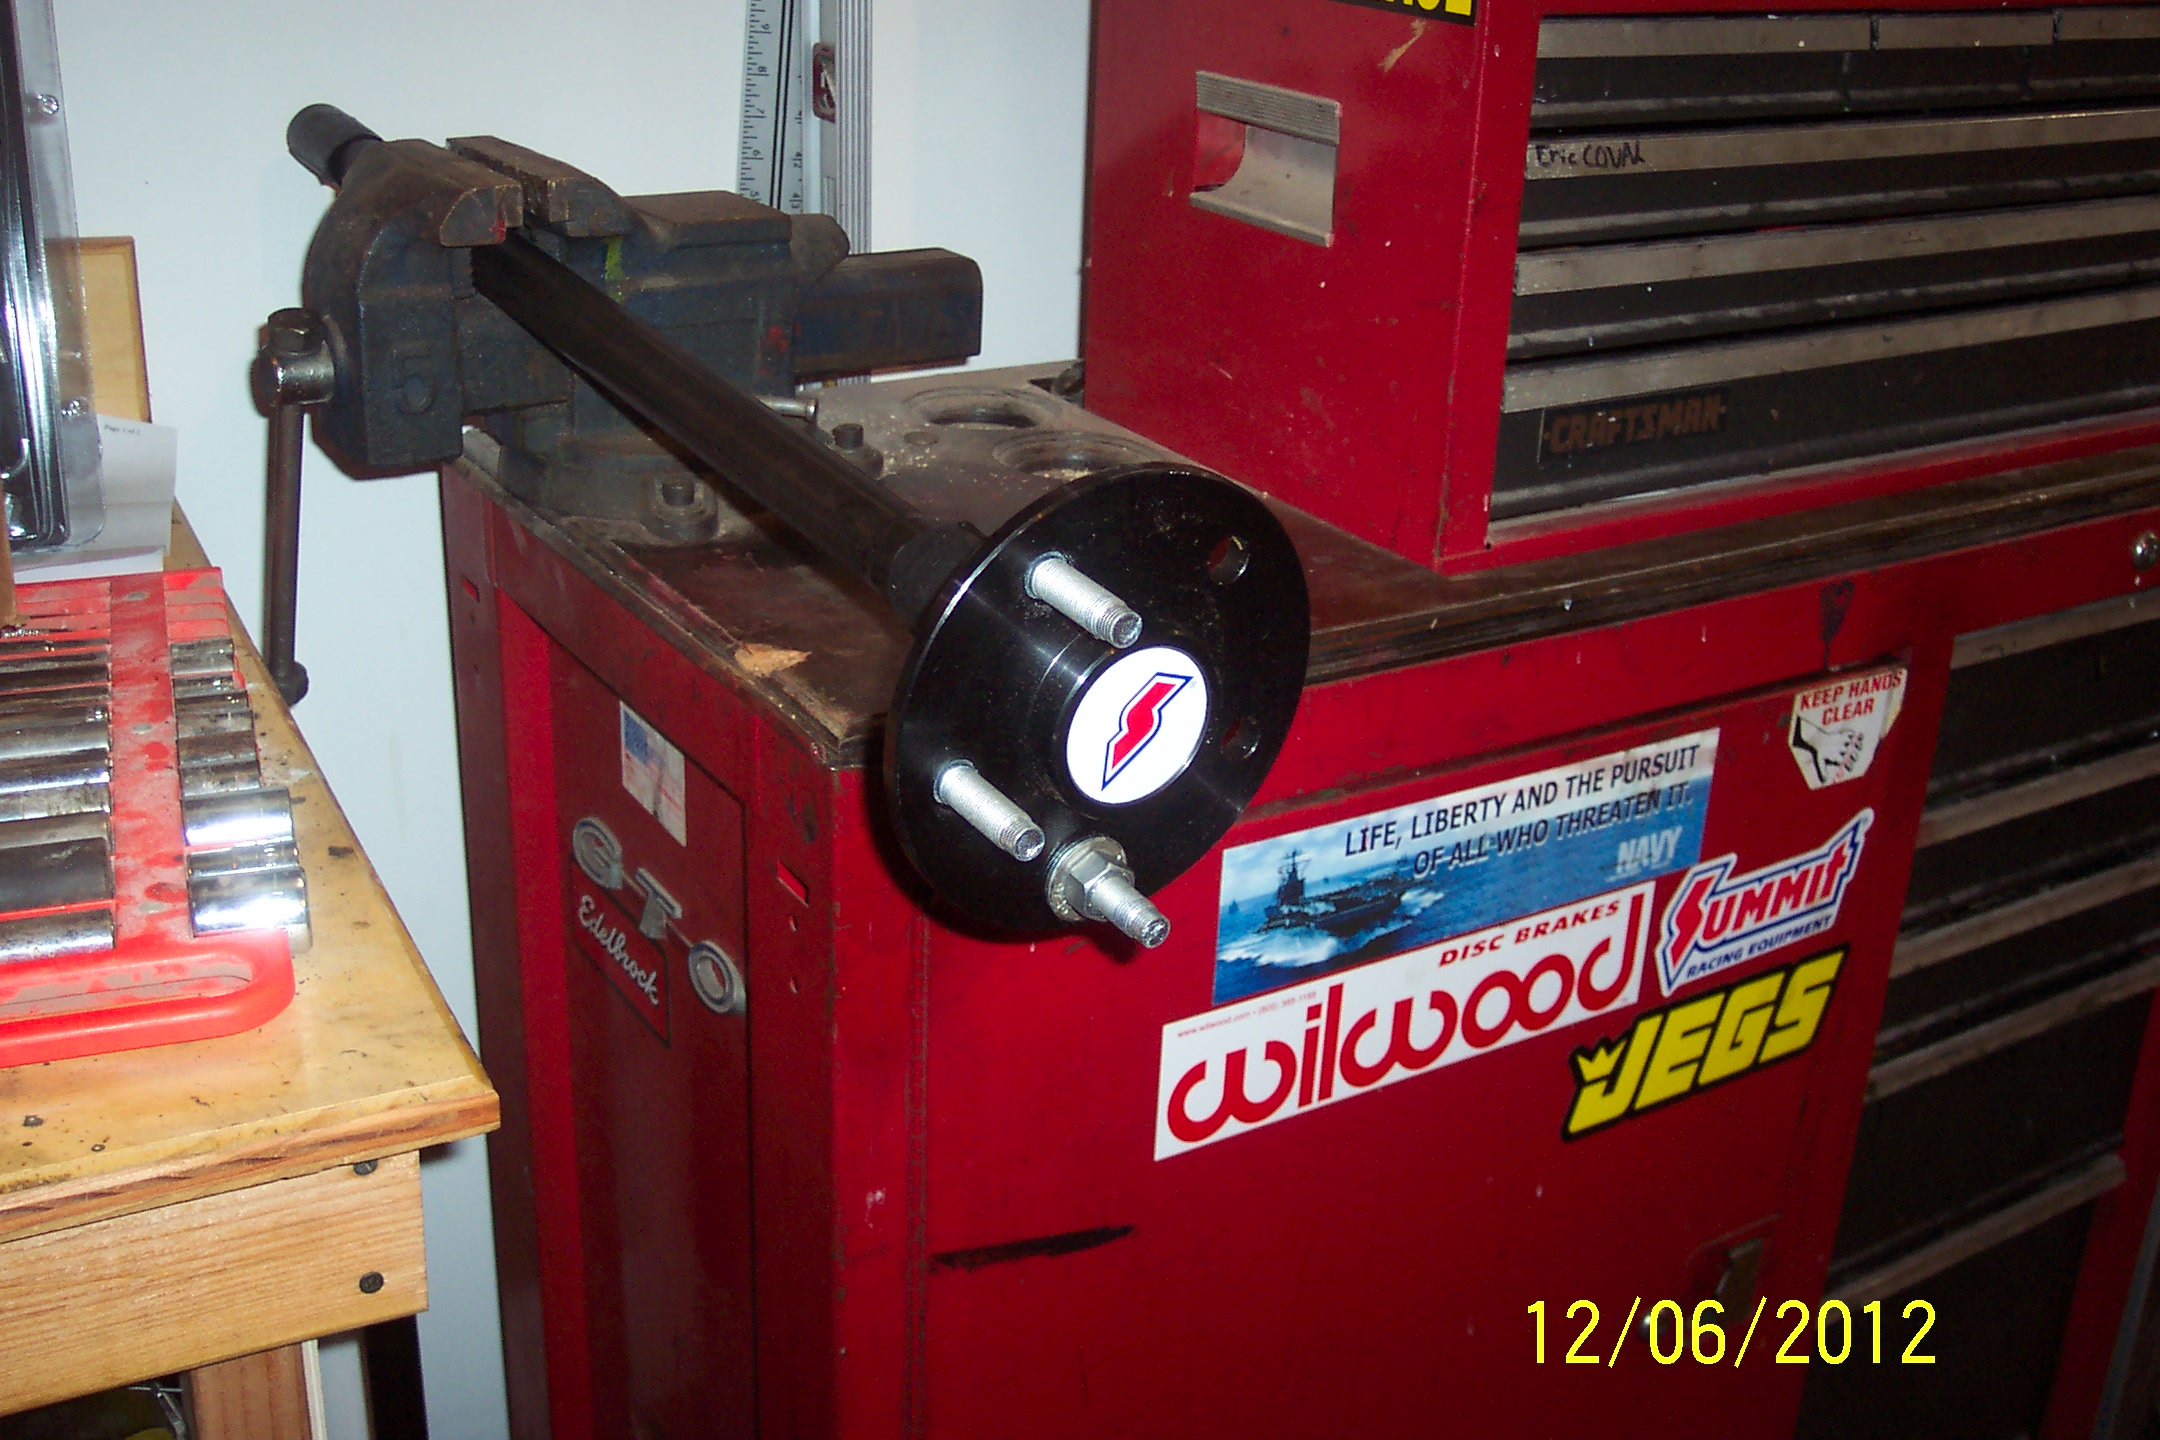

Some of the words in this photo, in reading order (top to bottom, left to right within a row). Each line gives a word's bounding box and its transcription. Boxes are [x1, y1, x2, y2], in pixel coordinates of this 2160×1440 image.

[1534, 143, 1578, 168] Eric
[1551, 394, 1722, 452] CRAFTSMAN
[1801, 686, 1844, 711] KEEP
[1848, 670, 1902, 699] HANDS
[1821, 698, 1875, 726] CLEAR
[1345, 821, 1402, 857] LIFE,
[1411, 793, 1507, 840] LIBERTY
[1512, 780, 1558, 814] AND
[1566, 767, 1605, 798] THE
[1610, 744, 1700, 788] PURSUIT
[1413, 847, 1447, 878] OF
[1449, 832, 1489, 868] ALL
[1496, 819, 1550, 856] WHO
[1556, 788, 1662, 839] THREATEN
[1617, 826, 1683, 874] NAVY
[578, 894, 660, 1006] Edelbrock
[1439, 934, 1502, 968] DISC
[1513, 900, 1621, 946] BRAKES
[1687, 948, 1745, 978] RACING
[1748, 914, 1831, 957] EQUIPMENT
[1167, 893, 1645, 1143] wilwood
[1568, 949, 1847, 1134] JEGS
